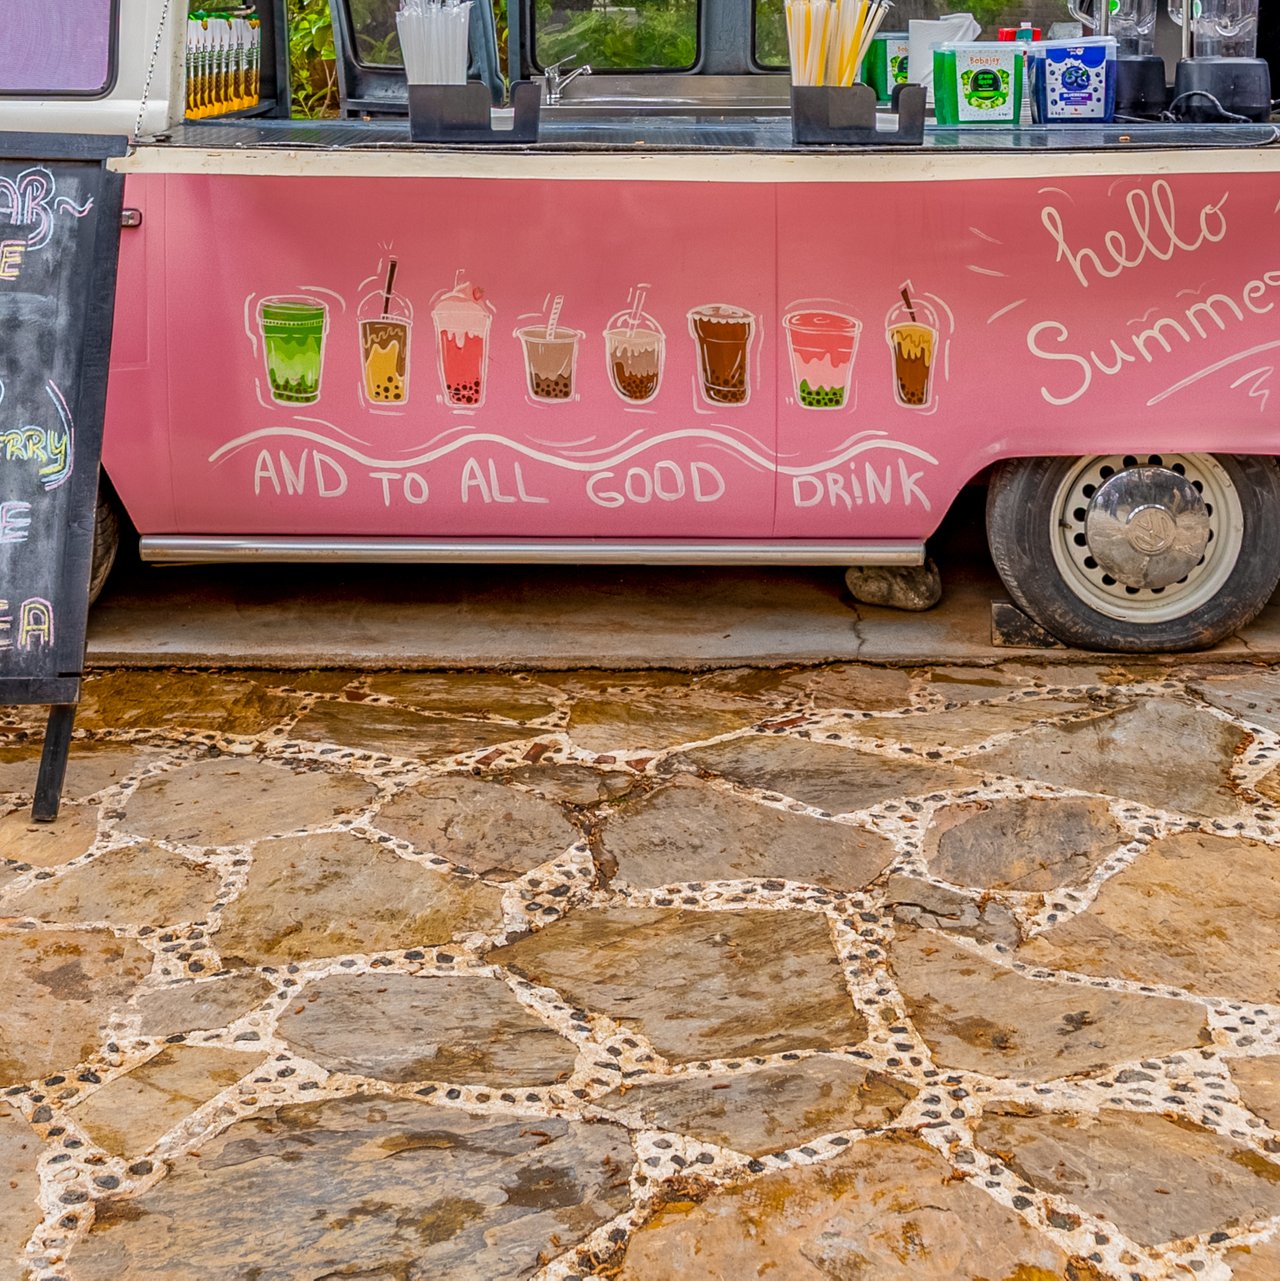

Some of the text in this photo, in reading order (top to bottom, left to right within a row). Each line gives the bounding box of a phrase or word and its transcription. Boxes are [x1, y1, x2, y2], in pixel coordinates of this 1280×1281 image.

[1041, 179, 1229, 288] hello
[254, 448, 348, 498] AND
[369, 471, 429, 507] TO
[461, 456, 549, 504] ALL
[586, 459, 725, 508] GOOD
